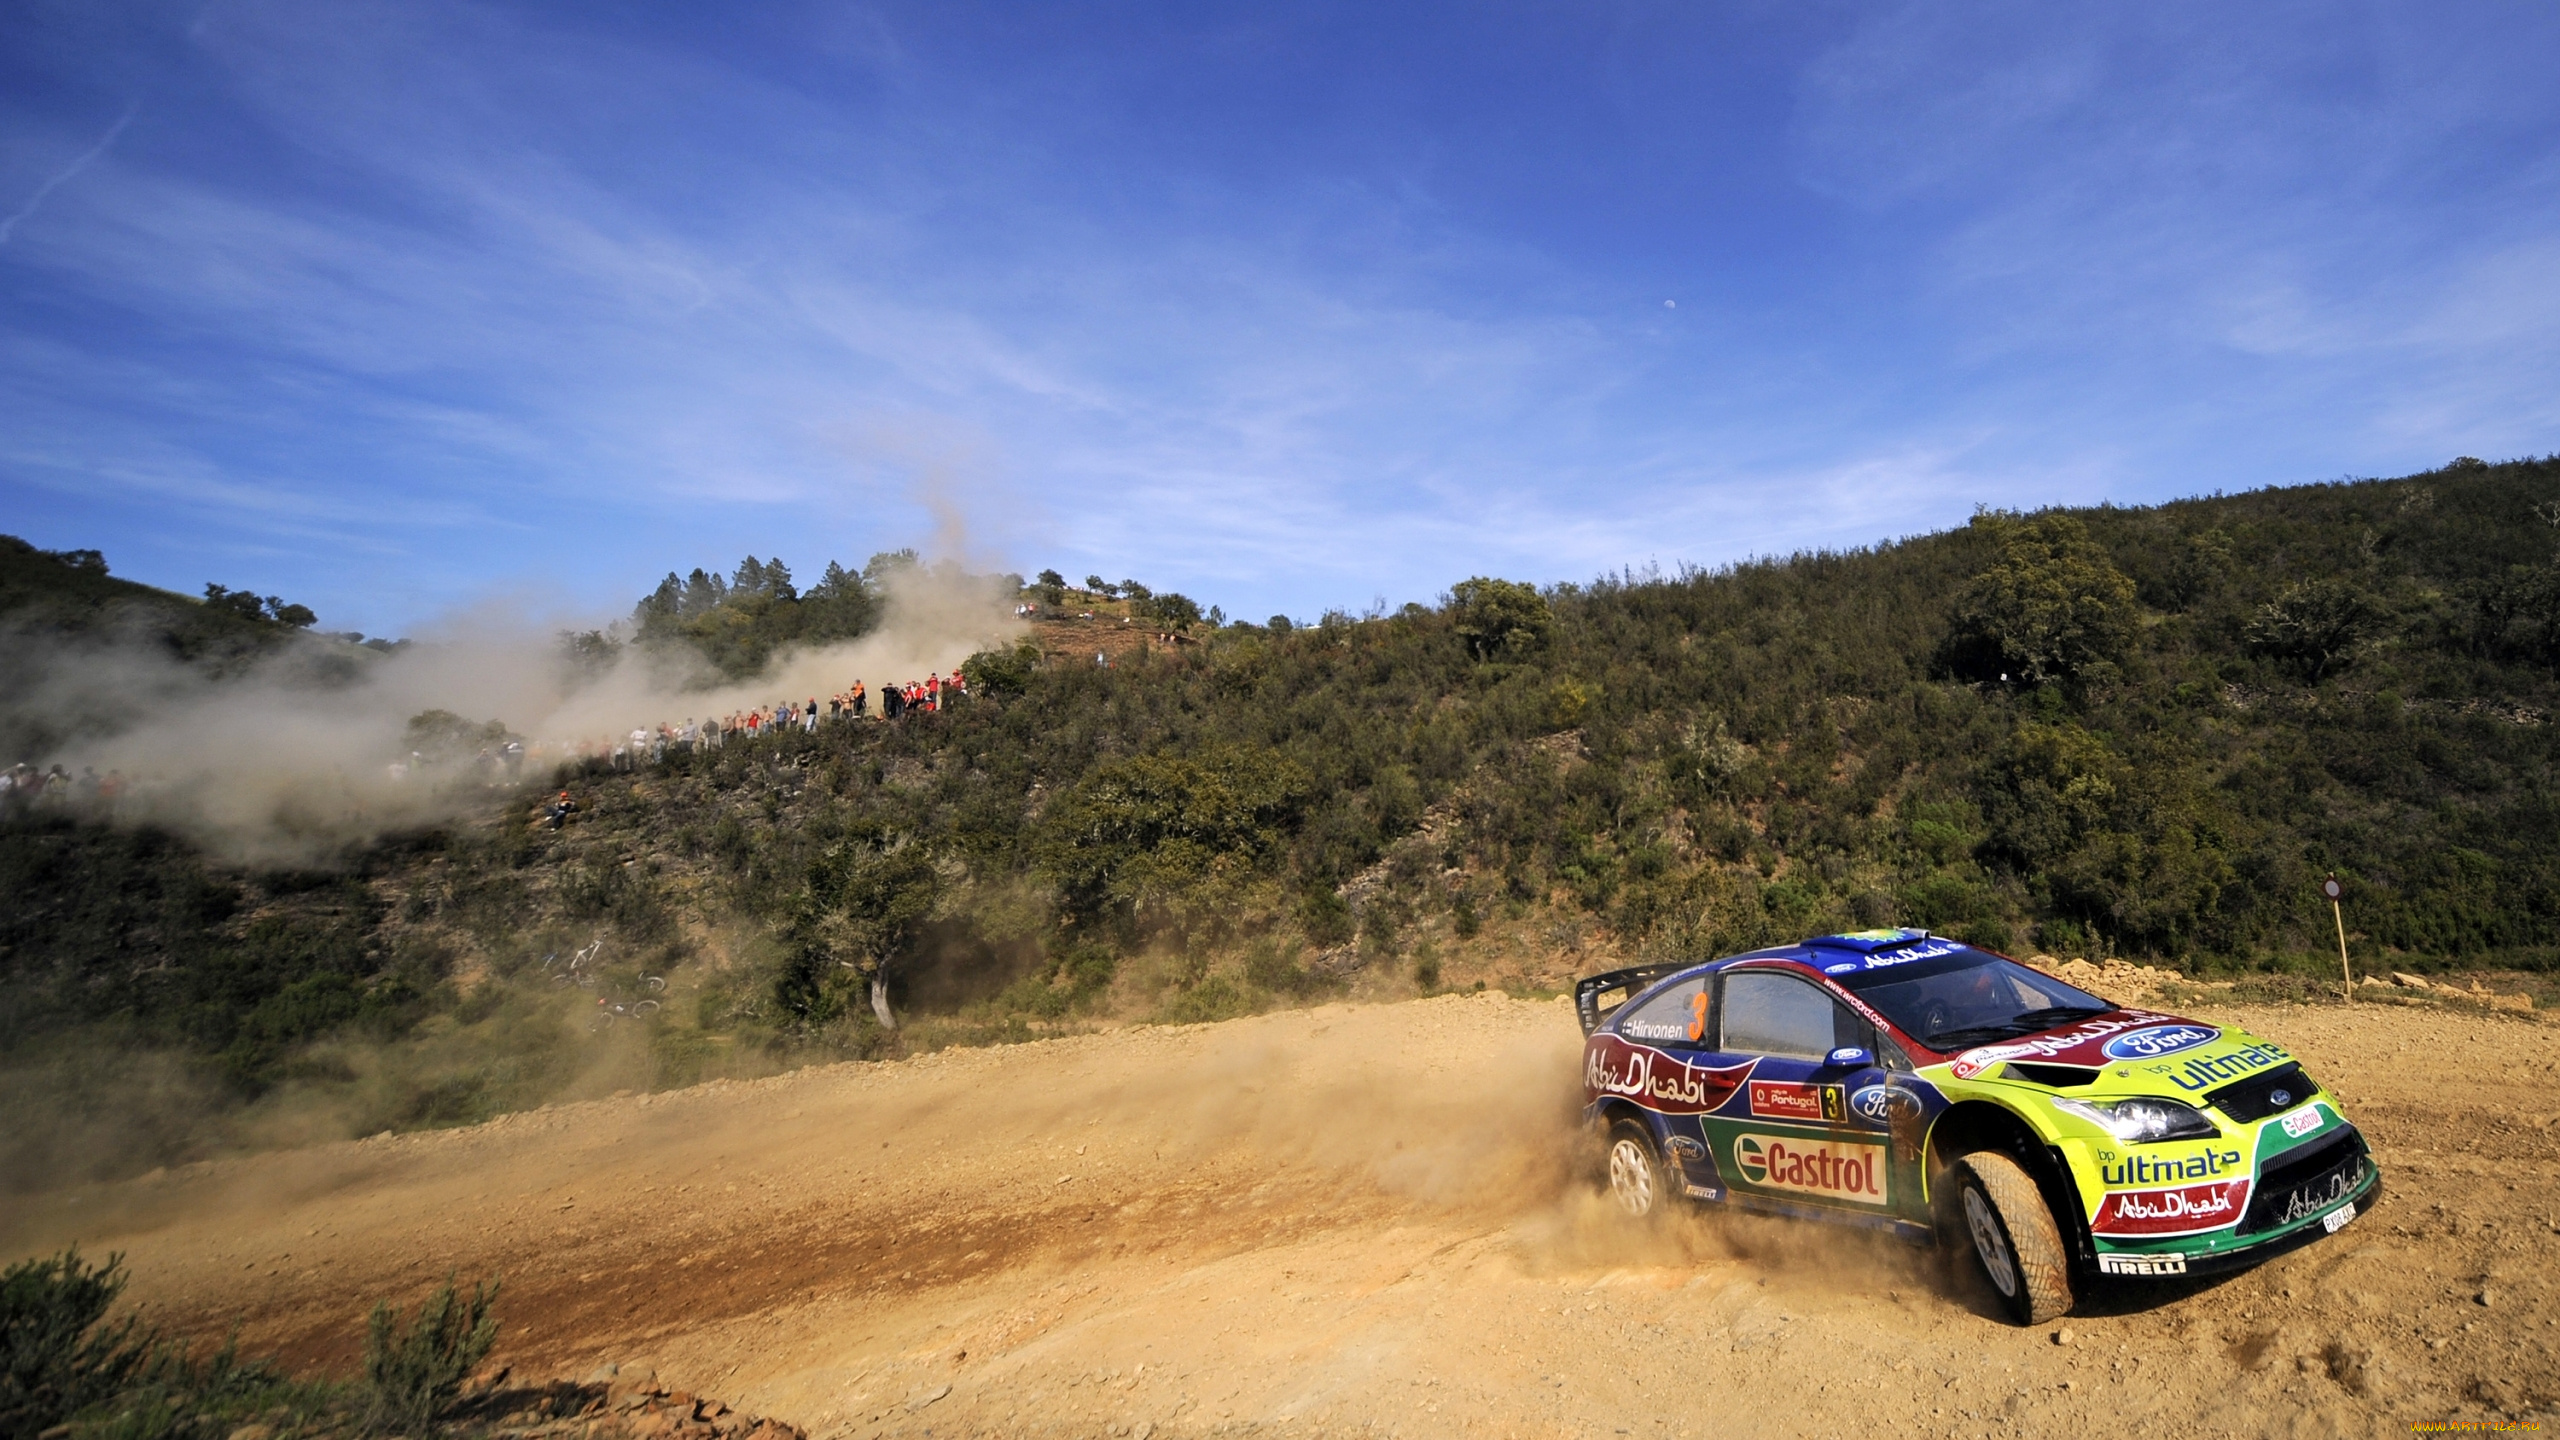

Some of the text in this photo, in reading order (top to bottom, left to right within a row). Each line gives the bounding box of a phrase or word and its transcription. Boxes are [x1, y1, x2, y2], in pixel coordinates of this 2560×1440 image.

[1688, 991, 1709, 1041] 3
[1824, 978, 1891, 1033] www.wrcford.com
[1631, 1020, 1683, 1039] Hirvonen
[2122, 1028, 2207, 1054] Ford
[2142, 1063, 2172, 1075] bp
[2168, 1042, 2290, 1091] ultimate
[1771, 1094, 1818, 1108] Portugal
[1826, 1087, 1839, 1119] 3
[2293, 1110, 2321, 1132] Castrol
[1673, 1138, 1699, 1158] Ford
[2097, 1148, 2116, 1164] bp
[1769, 1143, 1879, 1196] Castrol
[2098, 1252, 2187, 1275] PIRELLI
